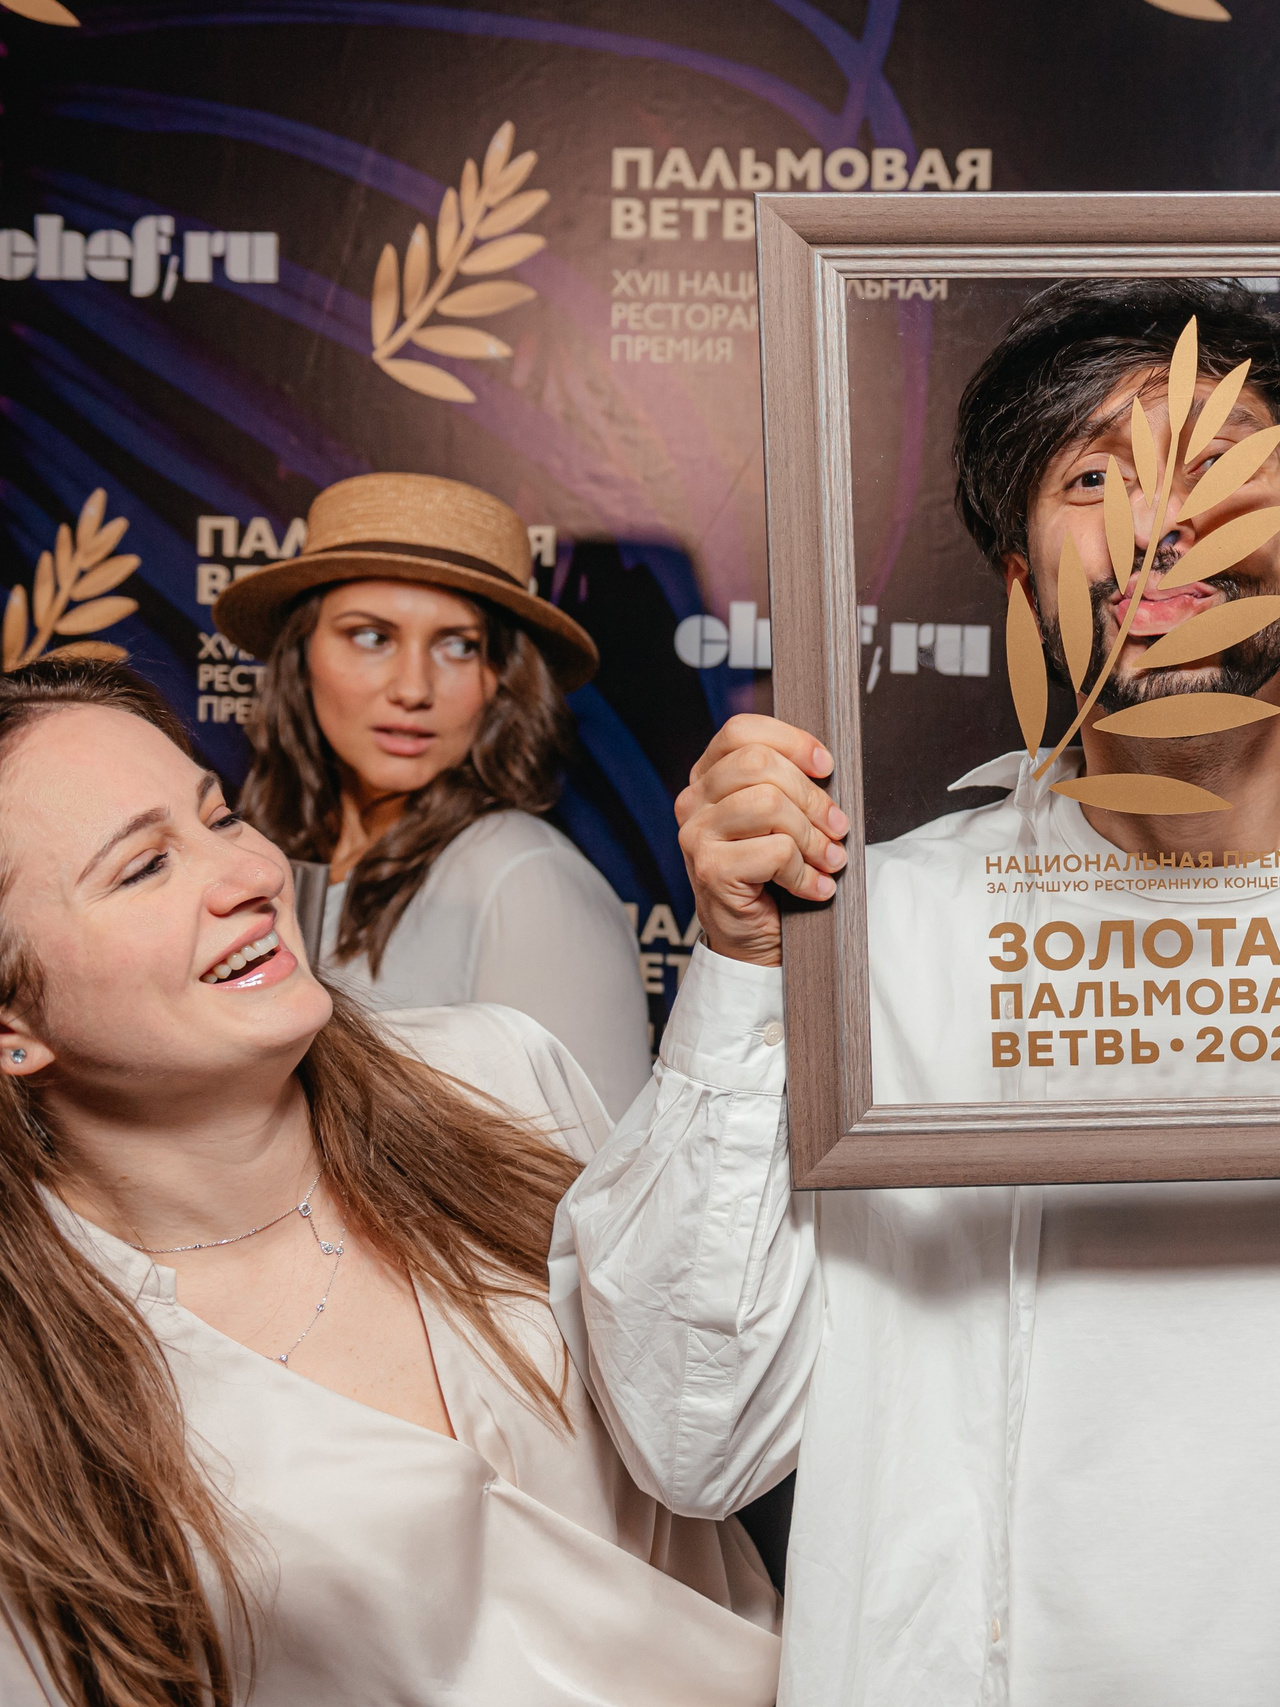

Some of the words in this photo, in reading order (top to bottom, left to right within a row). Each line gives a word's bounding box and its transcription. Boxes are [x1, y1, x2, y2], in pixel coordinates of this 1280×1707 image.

[611, 147, 992, 191] ПАЛЬМОВАЯ
[611, 198, 755, 240] ВЕТВ
[611, 303, 757, 332] РЕСТОРА
[610, 334, 733, 364] ПРЕМИЯ
[985, 851, 1213, 876] НАЦИОНАЛЬНАЯ
[986, 882, 1007, 894] ЗА
[1013, 880, 1089, 893] ЛУЧШУЮ
[1094, 877, 1219, 891] РЕСТОРАННУЮ
[991, 1028, 1160, 1068] ВЕТВЬ
